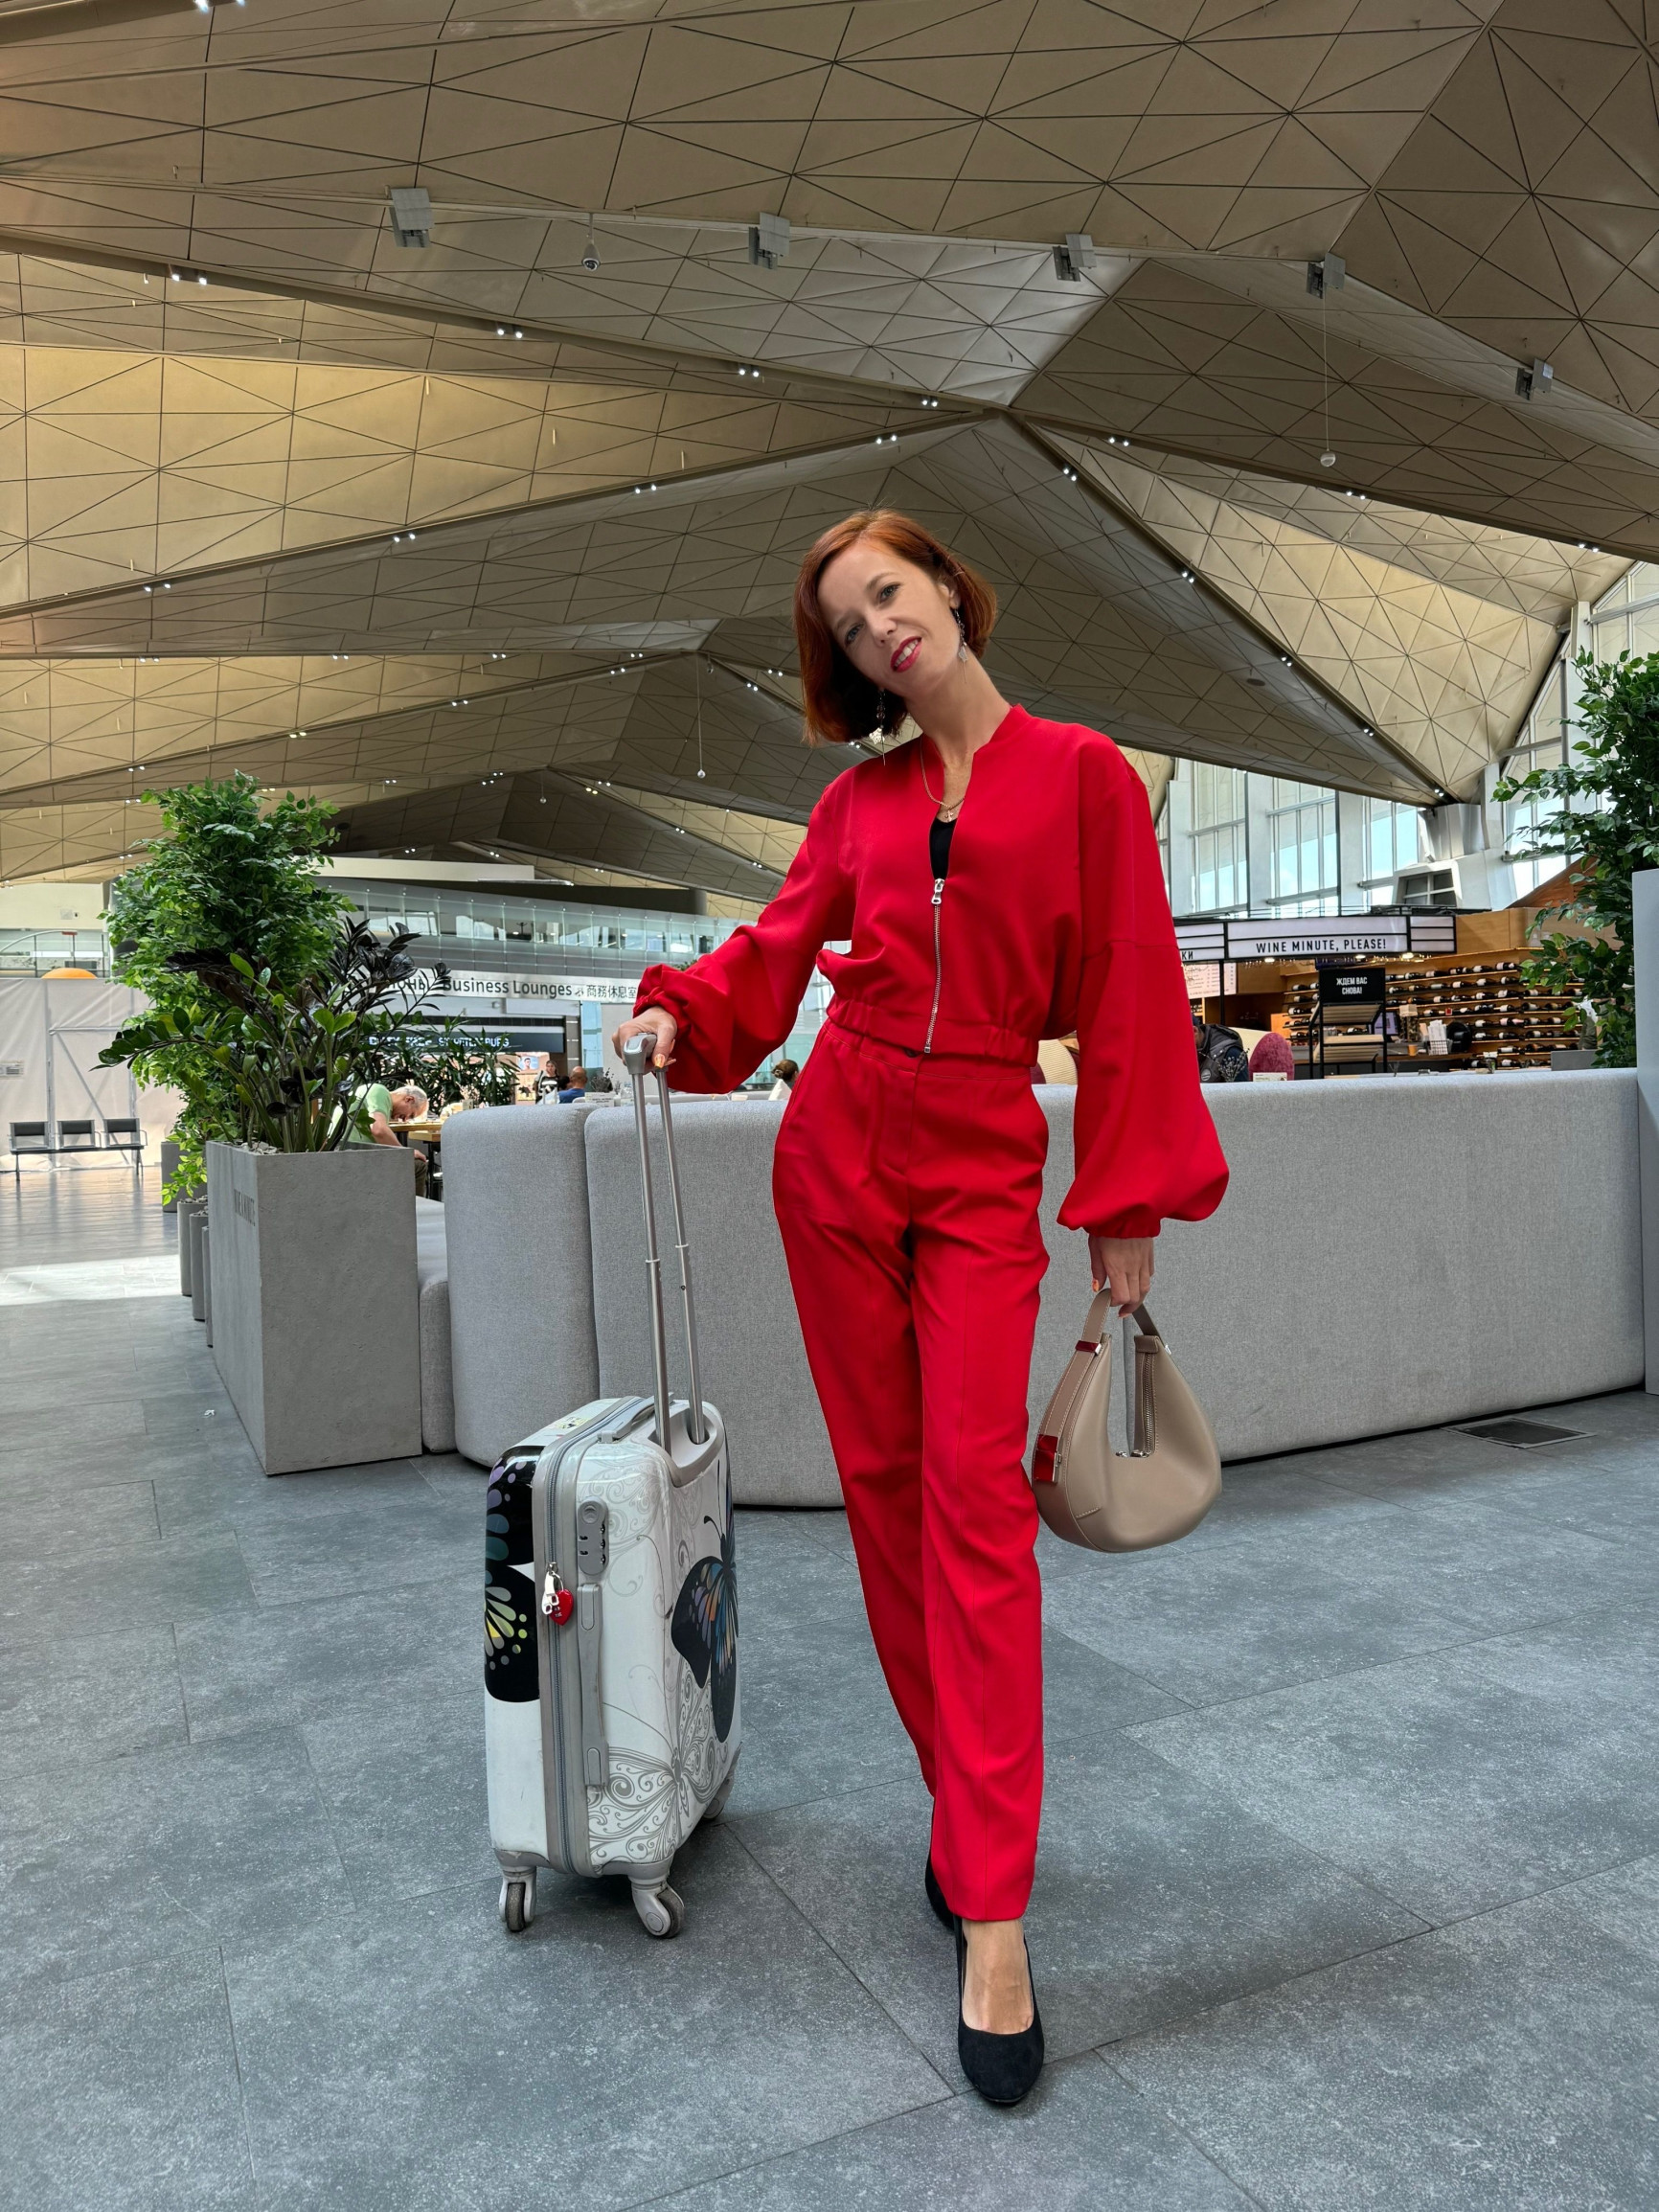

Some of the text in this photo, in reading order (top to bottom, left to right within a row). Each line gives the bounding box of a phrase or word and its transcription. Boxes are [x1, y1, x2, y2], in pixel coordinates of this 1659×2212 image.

[1256, 938, 1387, 953] WINE MINUTE, PLEASE!
[443, 976, 573, 999] Business Lounges
[1355, 976, 1368, 985] ВАС
